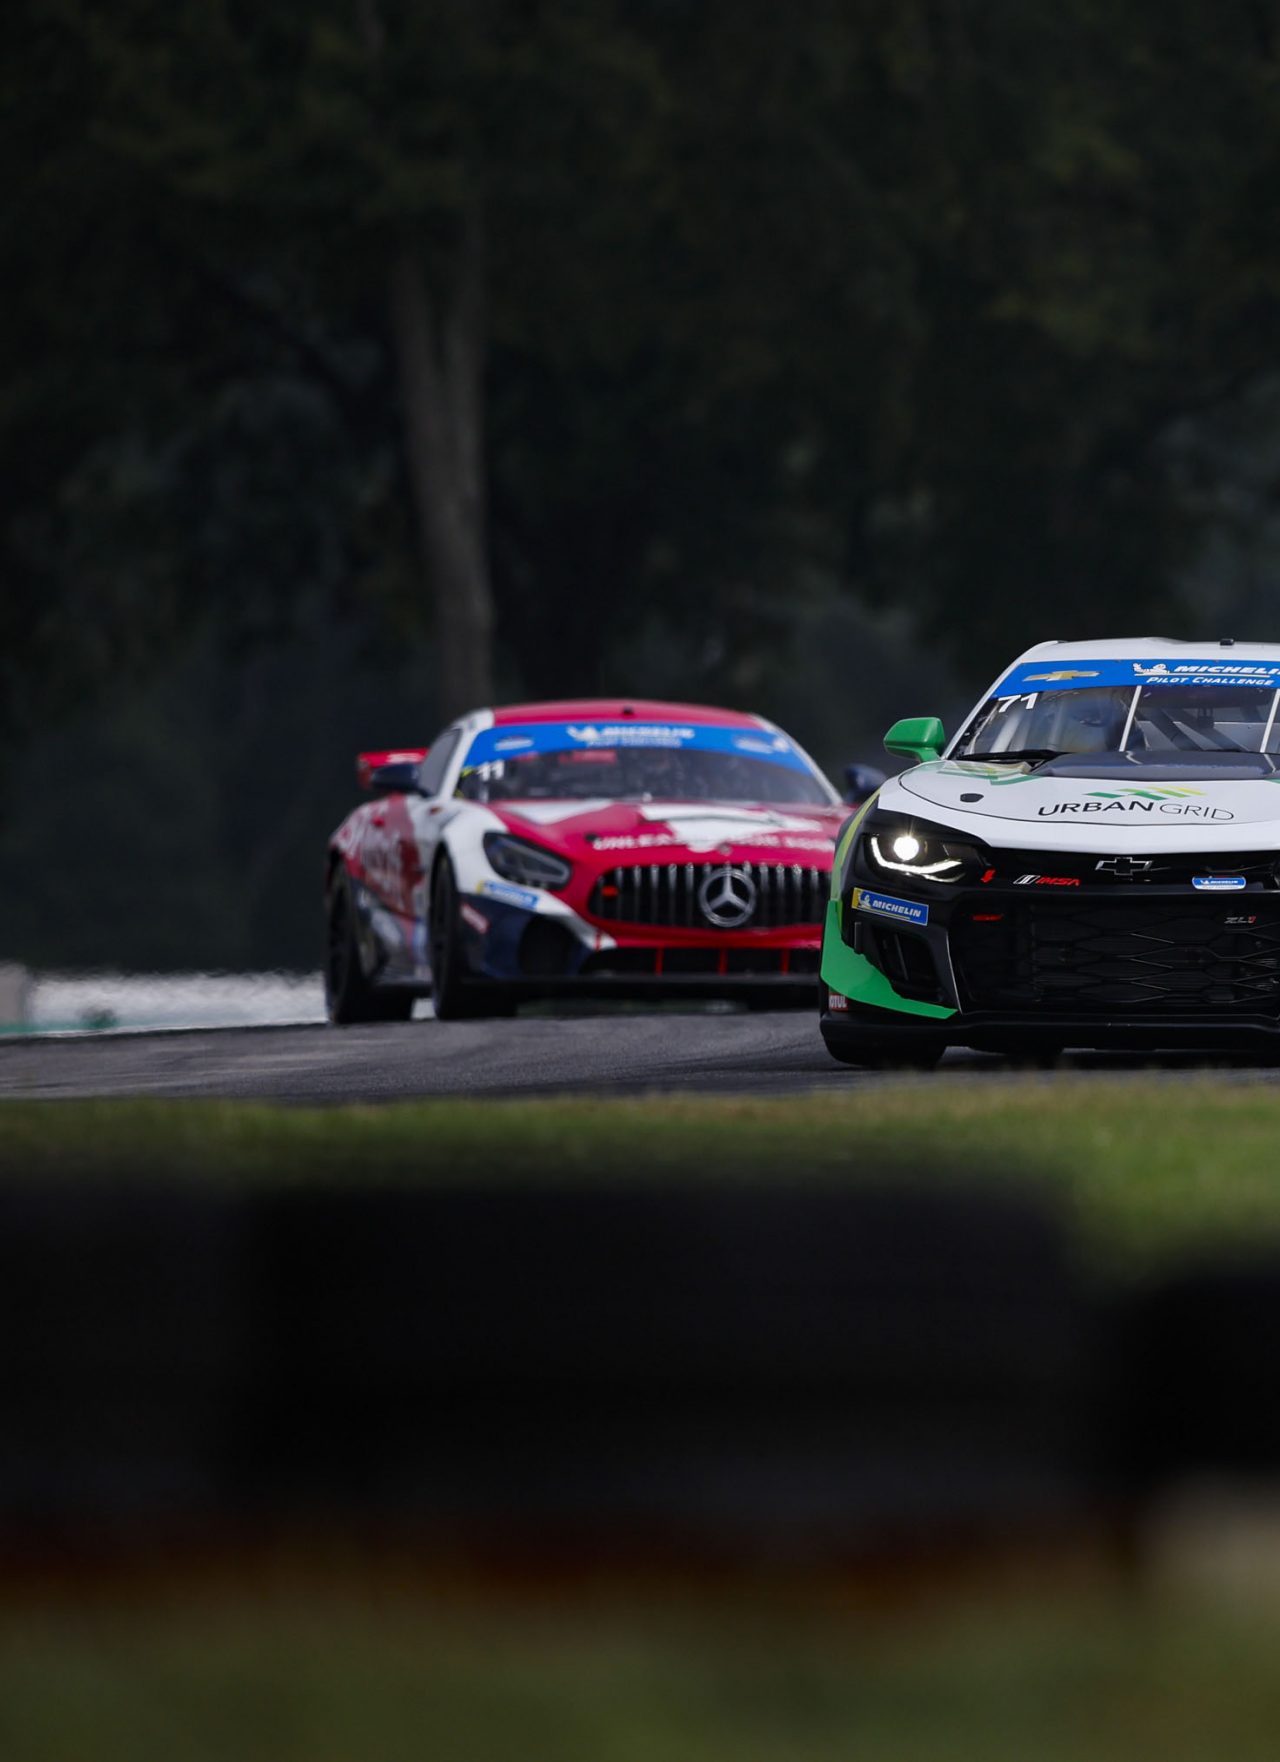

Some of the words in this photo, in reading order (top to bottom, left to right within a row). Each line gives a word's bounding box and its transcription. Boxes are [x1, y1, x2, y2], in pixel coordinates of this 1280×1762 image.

[1146, 676, 1190, 684] PILOT
[1192, 676, 1275, 686] CHALLENGE
[998, 692, 1039, 713] 71
[872, 900, 922, 918] MICHELIN
